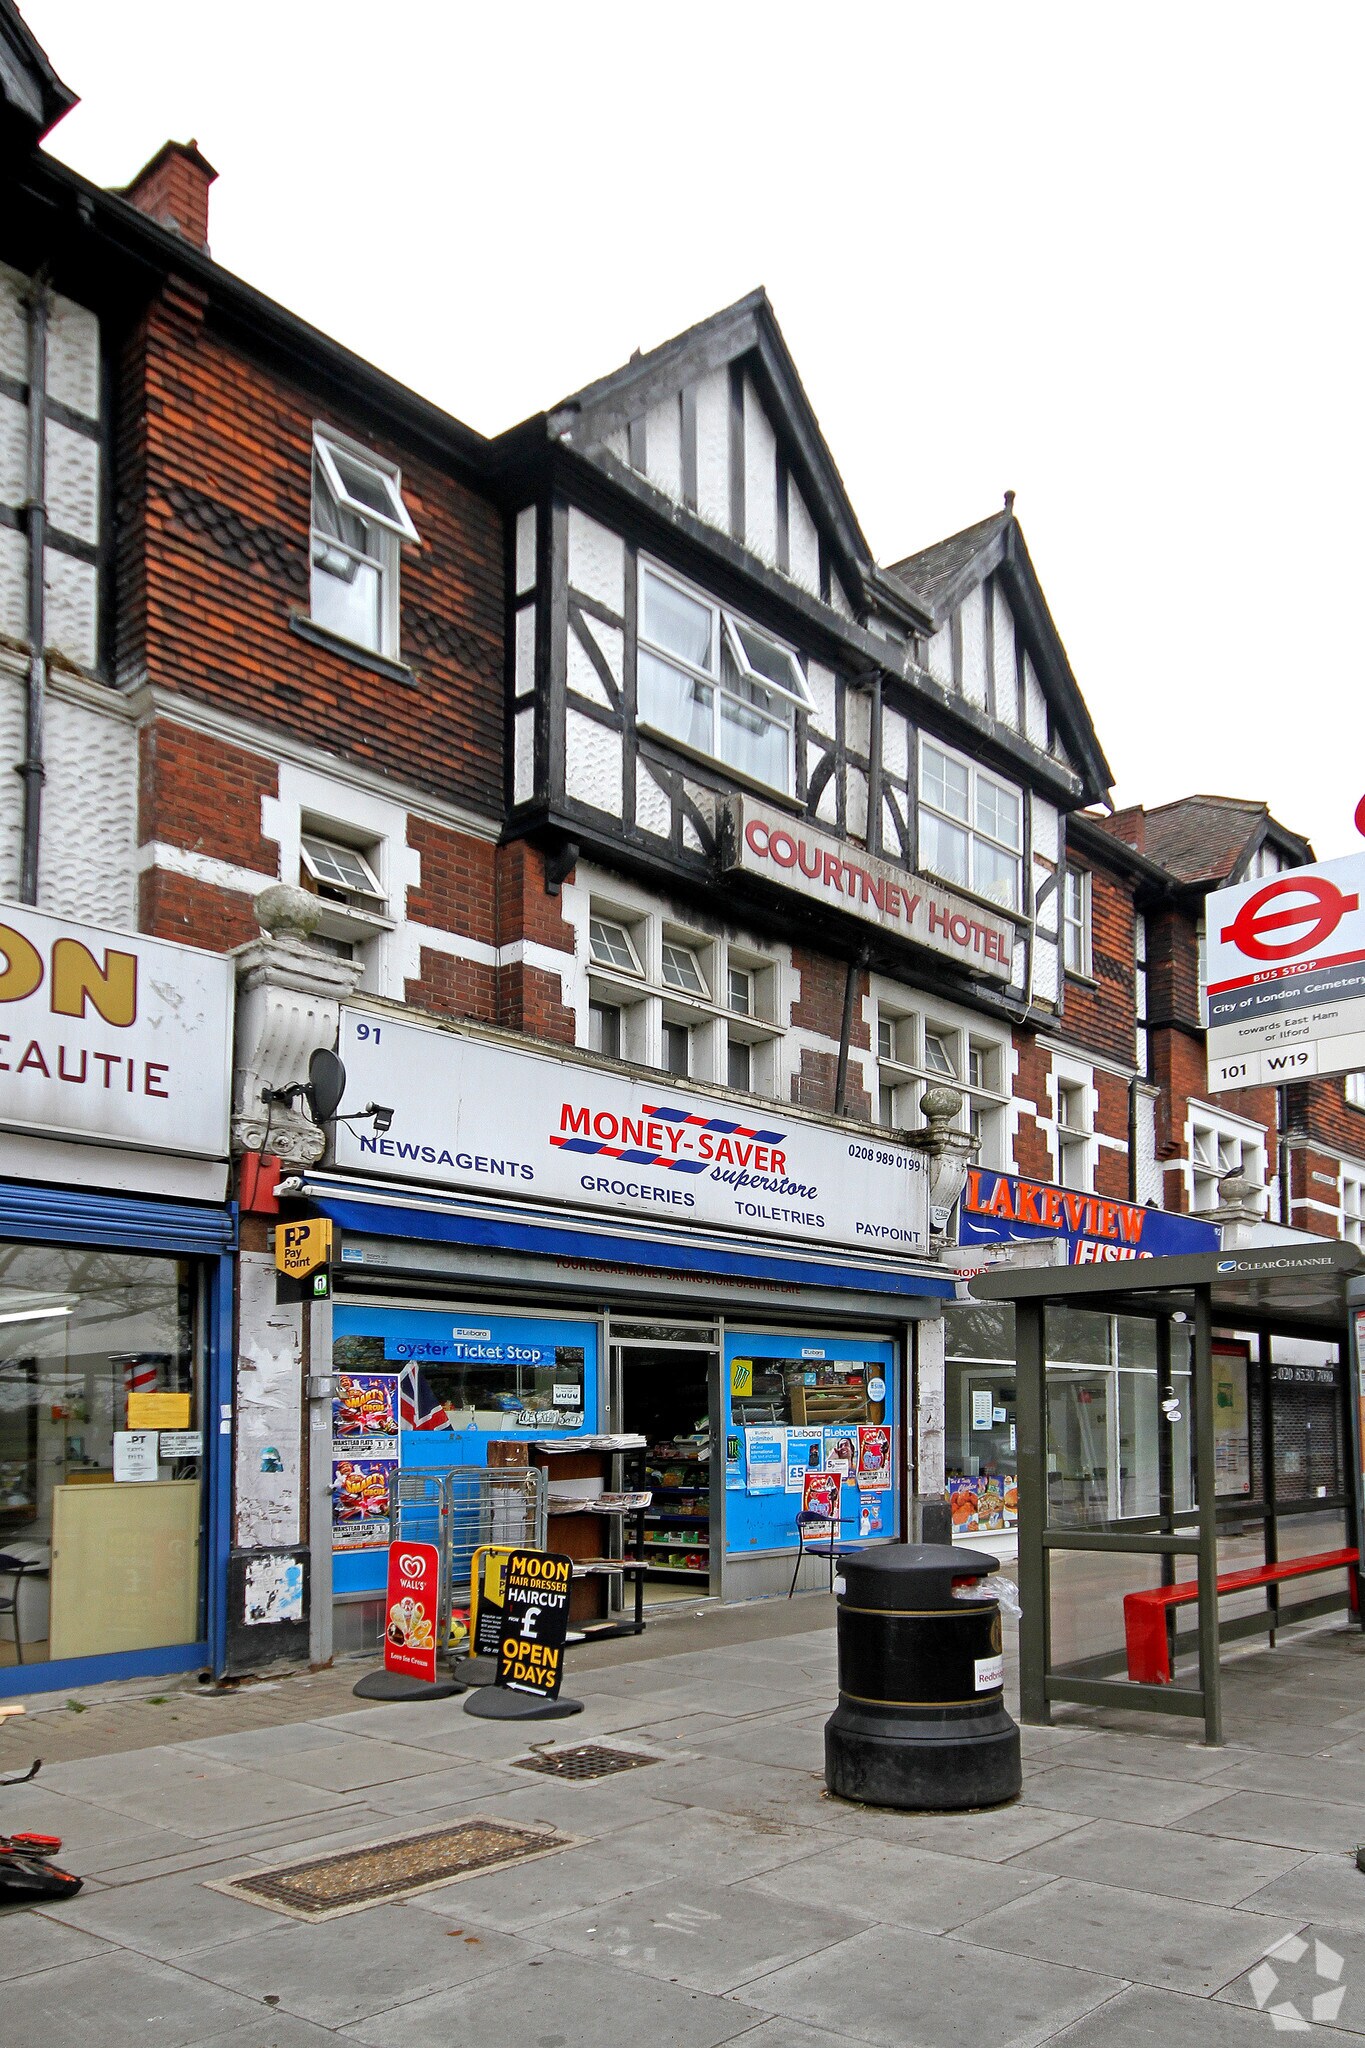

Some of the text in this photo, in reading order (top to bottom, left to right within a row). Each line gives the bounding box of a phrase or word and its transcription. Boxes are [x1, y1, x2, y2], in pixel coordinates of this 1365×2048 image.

[744, 819, 1011, 966] COURTNEY HOTEL
[1252, 961, 1318, 983] BUS STOP
[1212, 974, 1365, 1015] City of London Cemetery
[1237, 1009, 1339, 1036] towards East Ham
[1265, 1025, 1311, 1042] or Ilford
[356, 1023, 382, 1045] 91
[1220, 1063, 1248, 1080] 101
[1267, 1052, 1310, 1071] W19
[559, 1102, 787, 1176] MONEY-SAVER
[360, 1135, 535, 1181] NEWSAGENTS
[847, 1143, 921, 1173] 0208 989 0199
[580, 1175, 696, 1207] GROCERIES
[709, 1165, 819, 1200] superstore
[734, 1201, 826, 1228] TOILETRIES
[963, 1170, 1147, 1244] LAKEVIEW
[855, 1222, 921, 1244] PAYPOINT
[284, 1248, 302, 1260] Pay
[284, 1256, 311, 1269] Point
[555, 1259, 587, 1271] YOUR
[589, 1262, 624, 1276] LOCAL
[626, 1265, 664, 1279] MONEY
[666, 1271, 703, 1284] SAVING
[705, 1275, 734, 1288] STORE
[736, 1278, 761, 1291] OPEN
[780, 1283, 801, 1295] LATE
[953, 1267, 989, 1277] MONEY
[463, 1329, 487, 1337] Lebara
[396, 1341, 542, 1363] oyster Ticket Stop
[1278, 1367, 1294, 1381] 020
[344, 1388, 385, 1409] SMART'S
[362, 1404, 386, 1412] CIRCUS
[793, 1429, 822, 1438] Lebara
[830, 1428, 857, 1437] Lebara
[345, 1472, 385, 1494] SMART'S
[790, 1467, 804, 1478] £5
[363, 1488, 386, 1496] CIRCUS
[511, 1556, 570, 1582] MOON
[400, 1578, 424, 1591] WALL'S
[509, 1575, 530, 1588] HAIR
[530, 1577, 567, 1593] DRESSER
[508, 1588, 566, 1609] HAIRCUT
[519, 1607, 542, 1639] £
[390, 1652, 402, 1661] Love
[411, 1658, 428, 1667] Cream
[502, 1638, 559, 1669] OPEN
[502, 1660, 556, 1688] 7 DAYS
